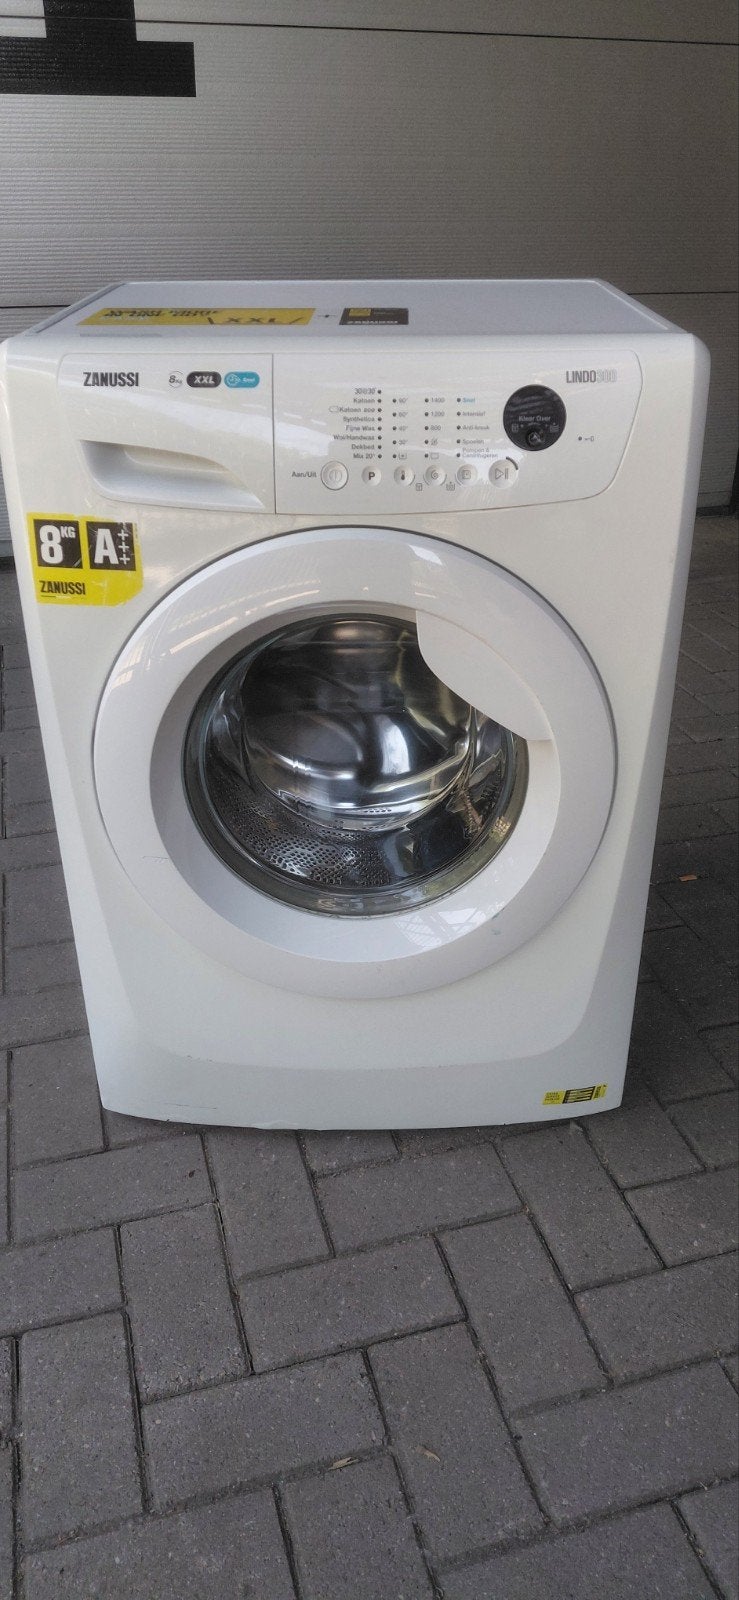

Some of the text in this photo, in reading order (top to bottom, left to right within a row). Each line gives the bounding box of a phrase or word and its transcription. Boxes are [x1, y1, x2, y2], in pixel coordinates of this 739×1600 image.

[83, 372, 139, 386] ZANUSSI
[193, 375, 215, 384] XXL
[368, 471, 376, 480] P
[40, 580, 86, 595] ZANUSSI
